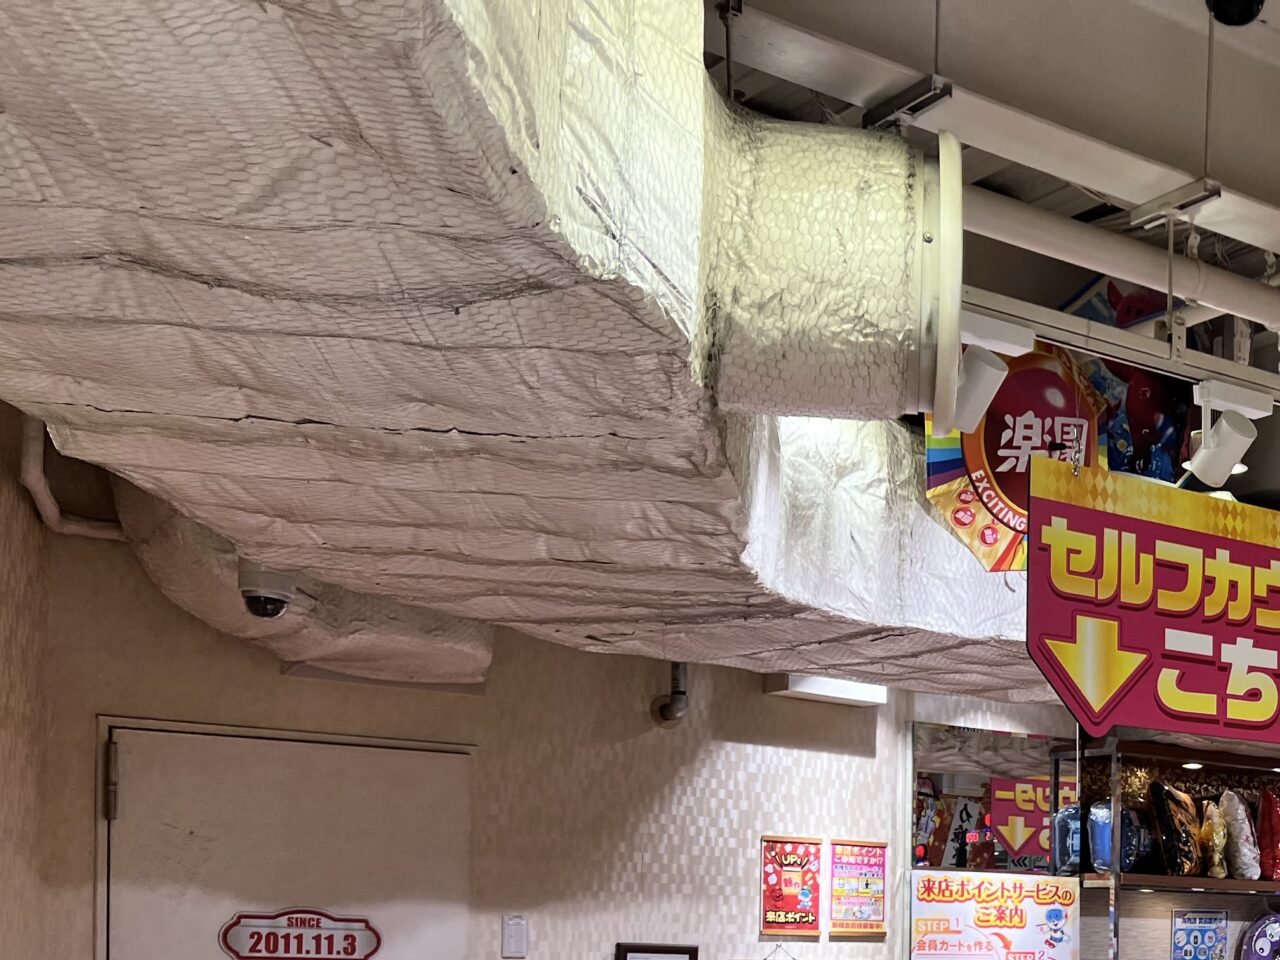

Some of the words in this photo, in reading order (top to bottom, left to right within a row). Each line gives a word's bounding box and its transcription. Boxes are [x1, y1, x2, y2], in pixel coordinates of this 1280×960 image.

[971, 470, 1027, 531] EXCITING
[919, 877, 1073, 902] 来店ポイントサービスの
[286, 917, 322, 928] SINCE
[765, 911, 816, 924] 来店ポイント
[977, 905, 1023, 924] ご案内
[918, 920, 948, 932] STEP
[249, 930, 357, 956] 2011.11.3
[916, 939, 994, 953] 会員カードを作る
